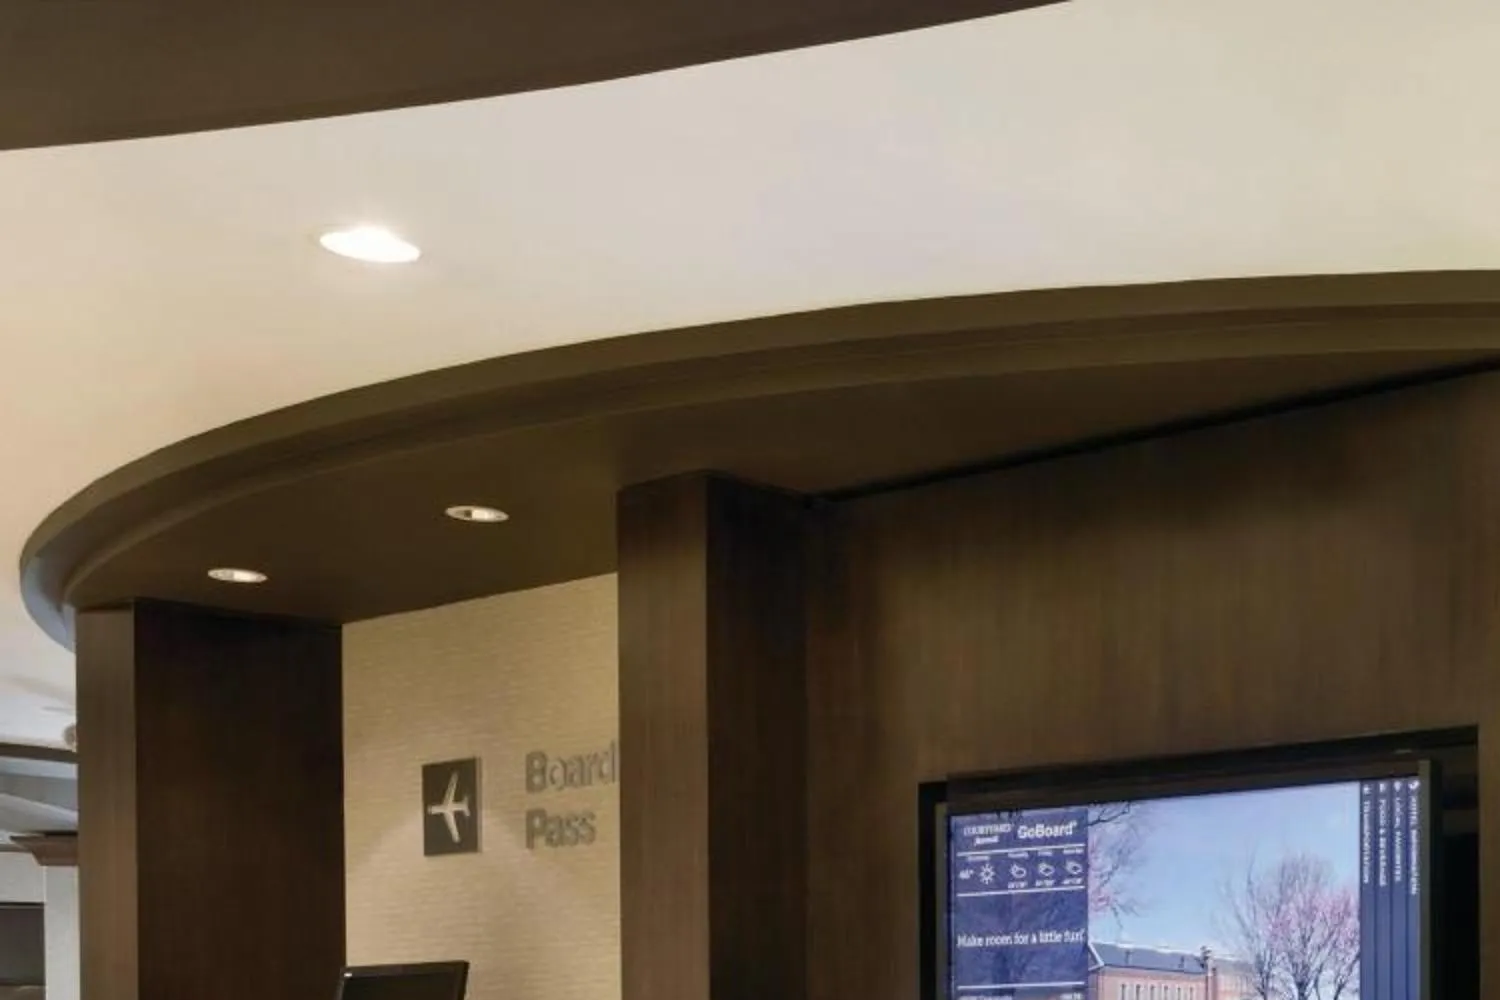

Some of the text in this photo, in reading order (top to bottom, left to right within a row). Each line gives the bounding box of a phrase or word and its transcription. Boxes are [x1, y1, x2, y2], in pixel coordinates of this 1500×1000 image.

[525, 740, 618, 794] Board
[525, 808, 597, 849] Pass
[956, 933, 983, 948] Make
[985, 934, 1013, 947] room
[1013, 930, 1030, 945] for
